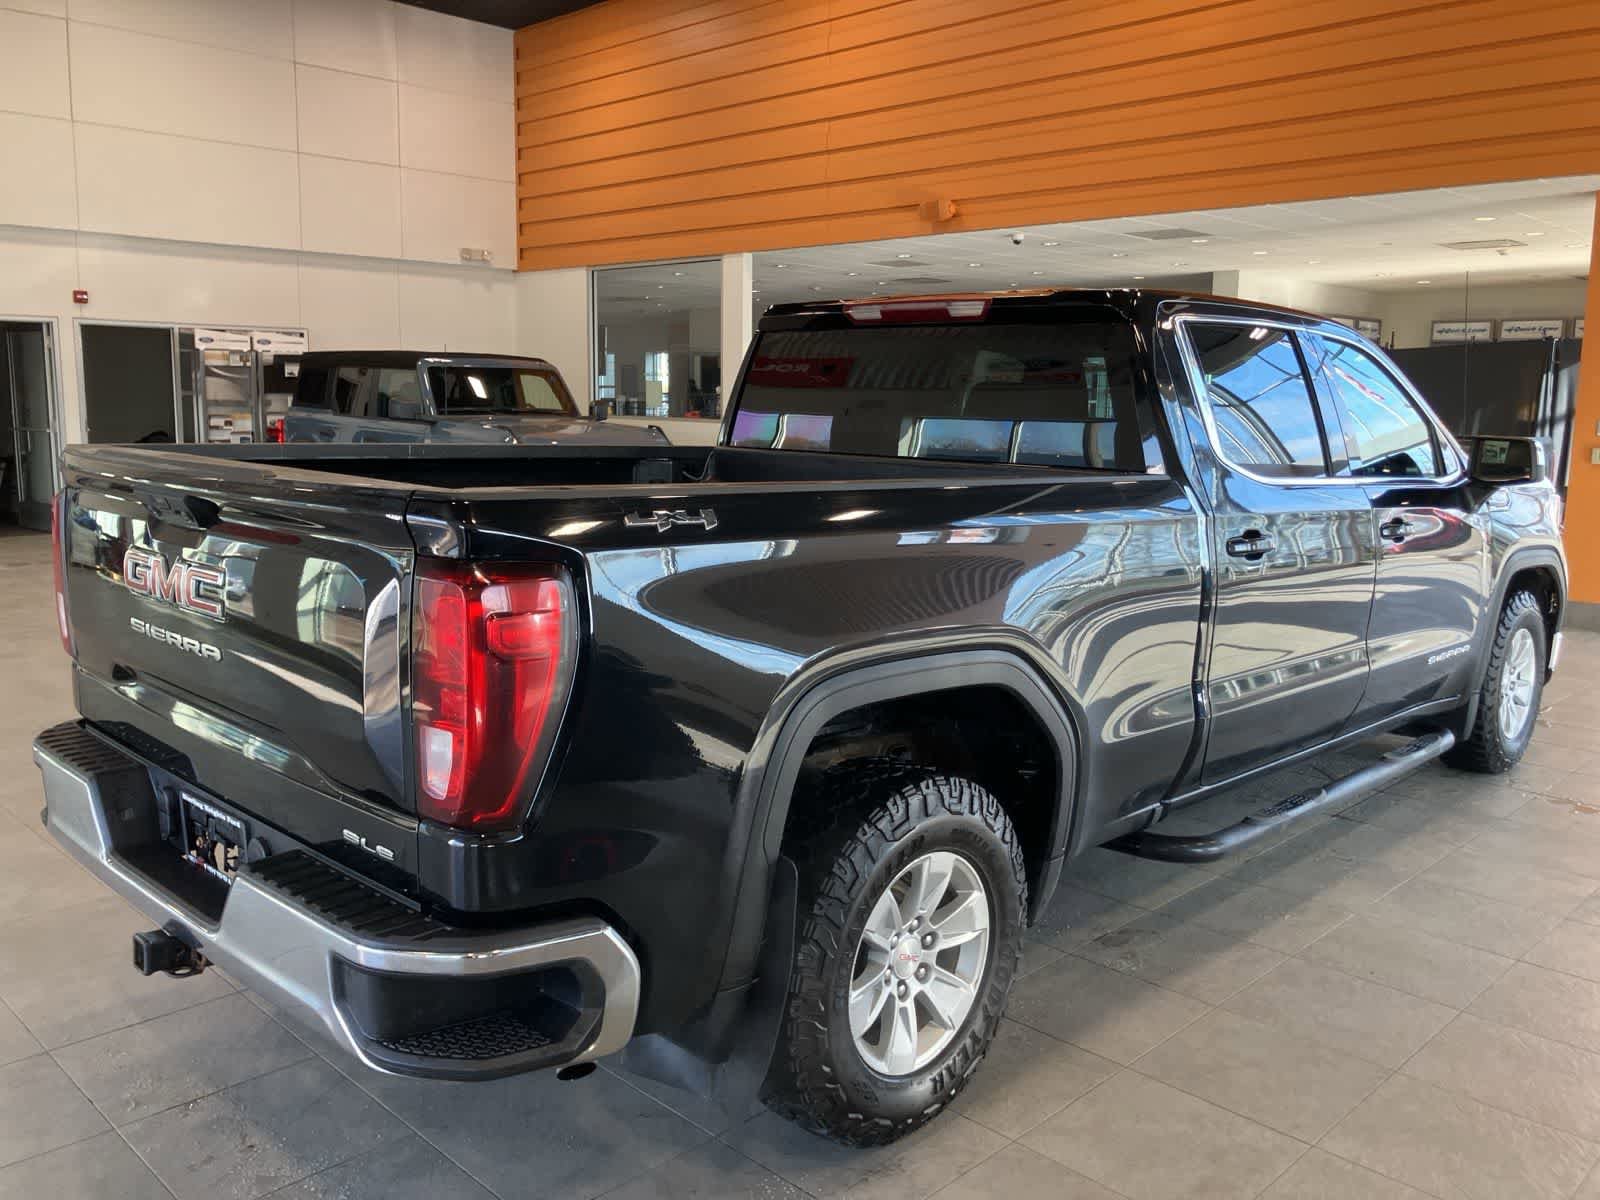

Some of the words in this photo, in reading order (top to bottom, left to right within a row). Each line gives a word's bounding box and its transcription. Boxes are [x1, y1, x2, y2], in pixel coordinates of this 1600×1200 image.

[124, 546, 226, 622] GMC
[130, 617, 223, 661] SIERRA
[343, 829, 394, 861] SLE
